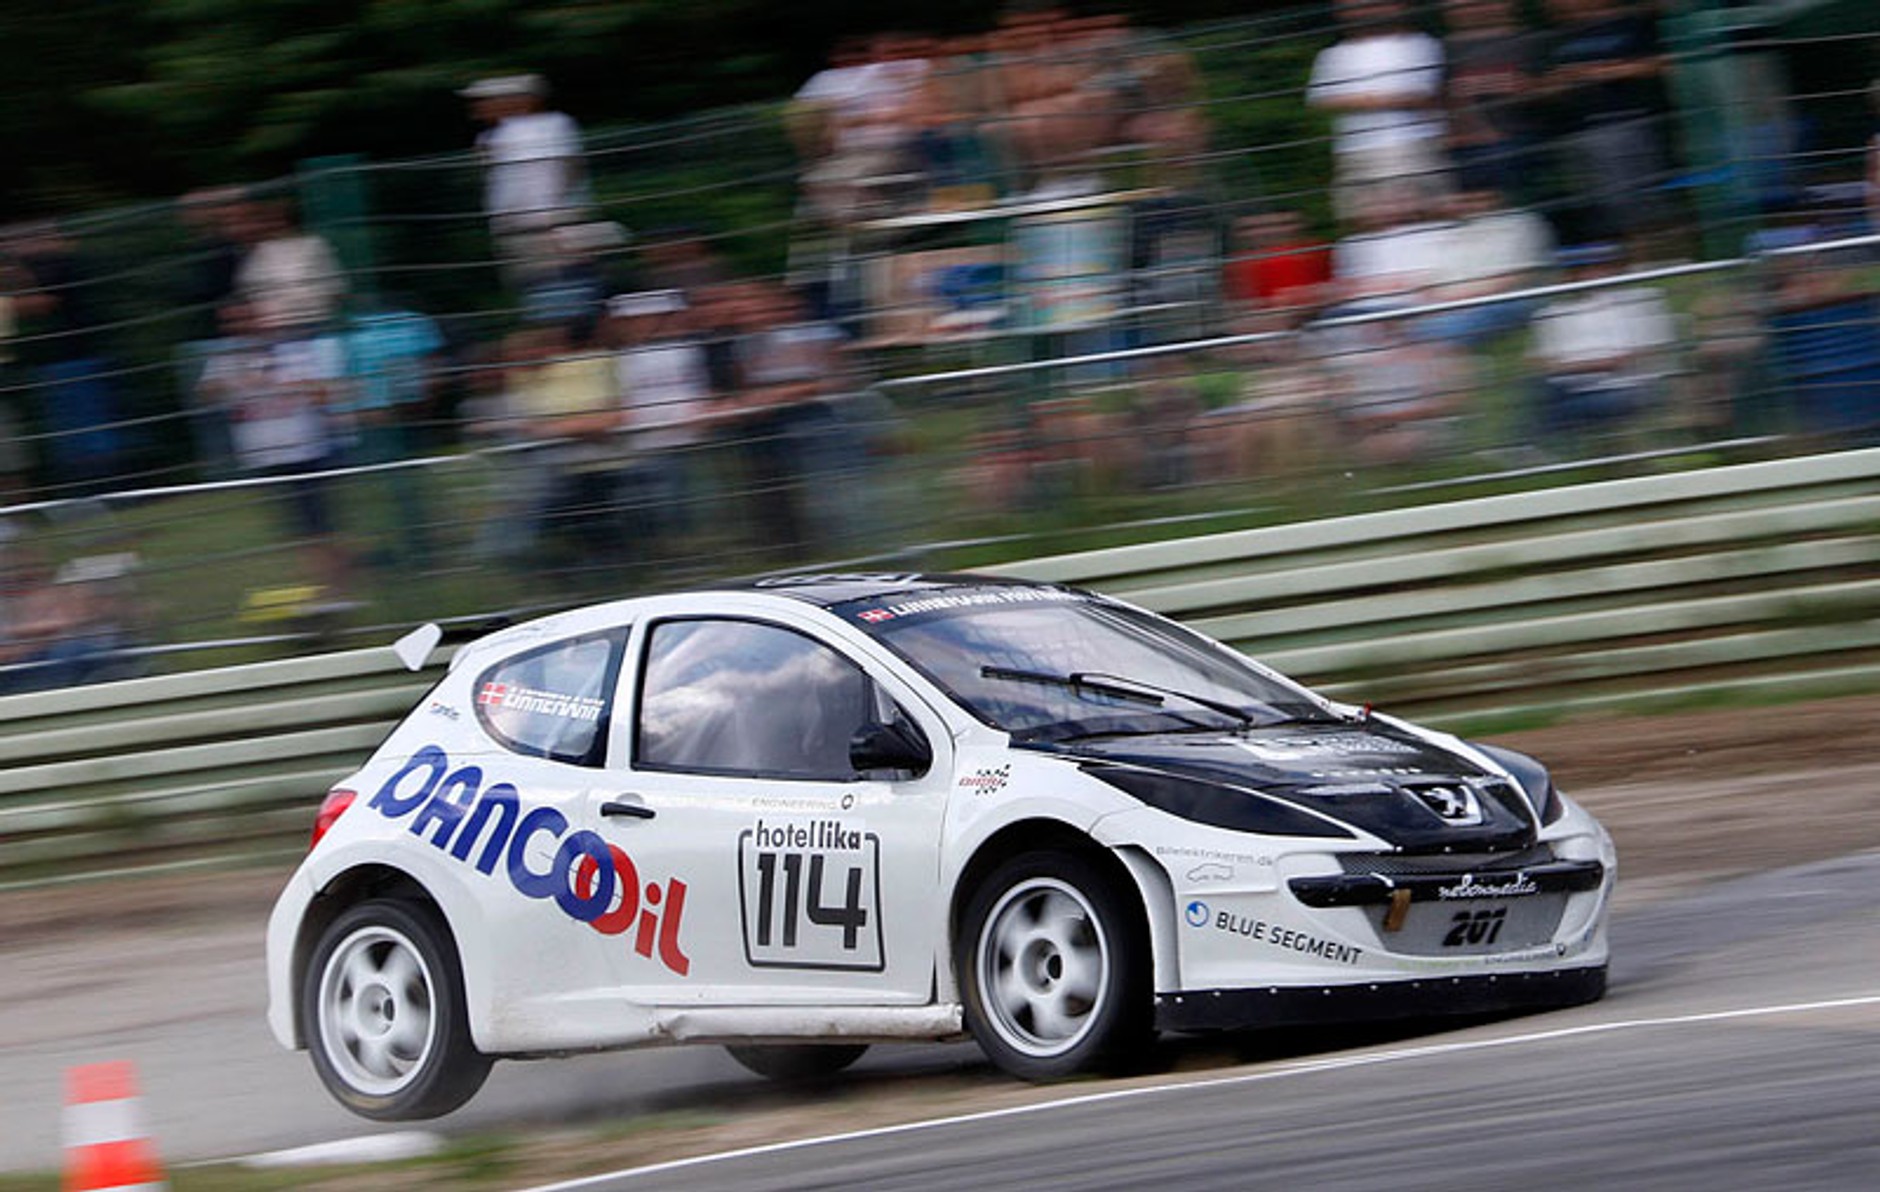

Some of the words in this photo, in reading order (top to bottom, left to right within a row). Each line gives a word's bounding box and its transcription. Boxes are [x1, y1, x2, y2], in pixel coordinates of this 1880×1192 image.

[756, 818, 815, 848] hotel
[818, 820, 861, 850] lika
[757, 852, 867, 949] 114
[1215, 911, 1267, 940] BLUE
[1268, 926, 1364, 965] SEGMENT
